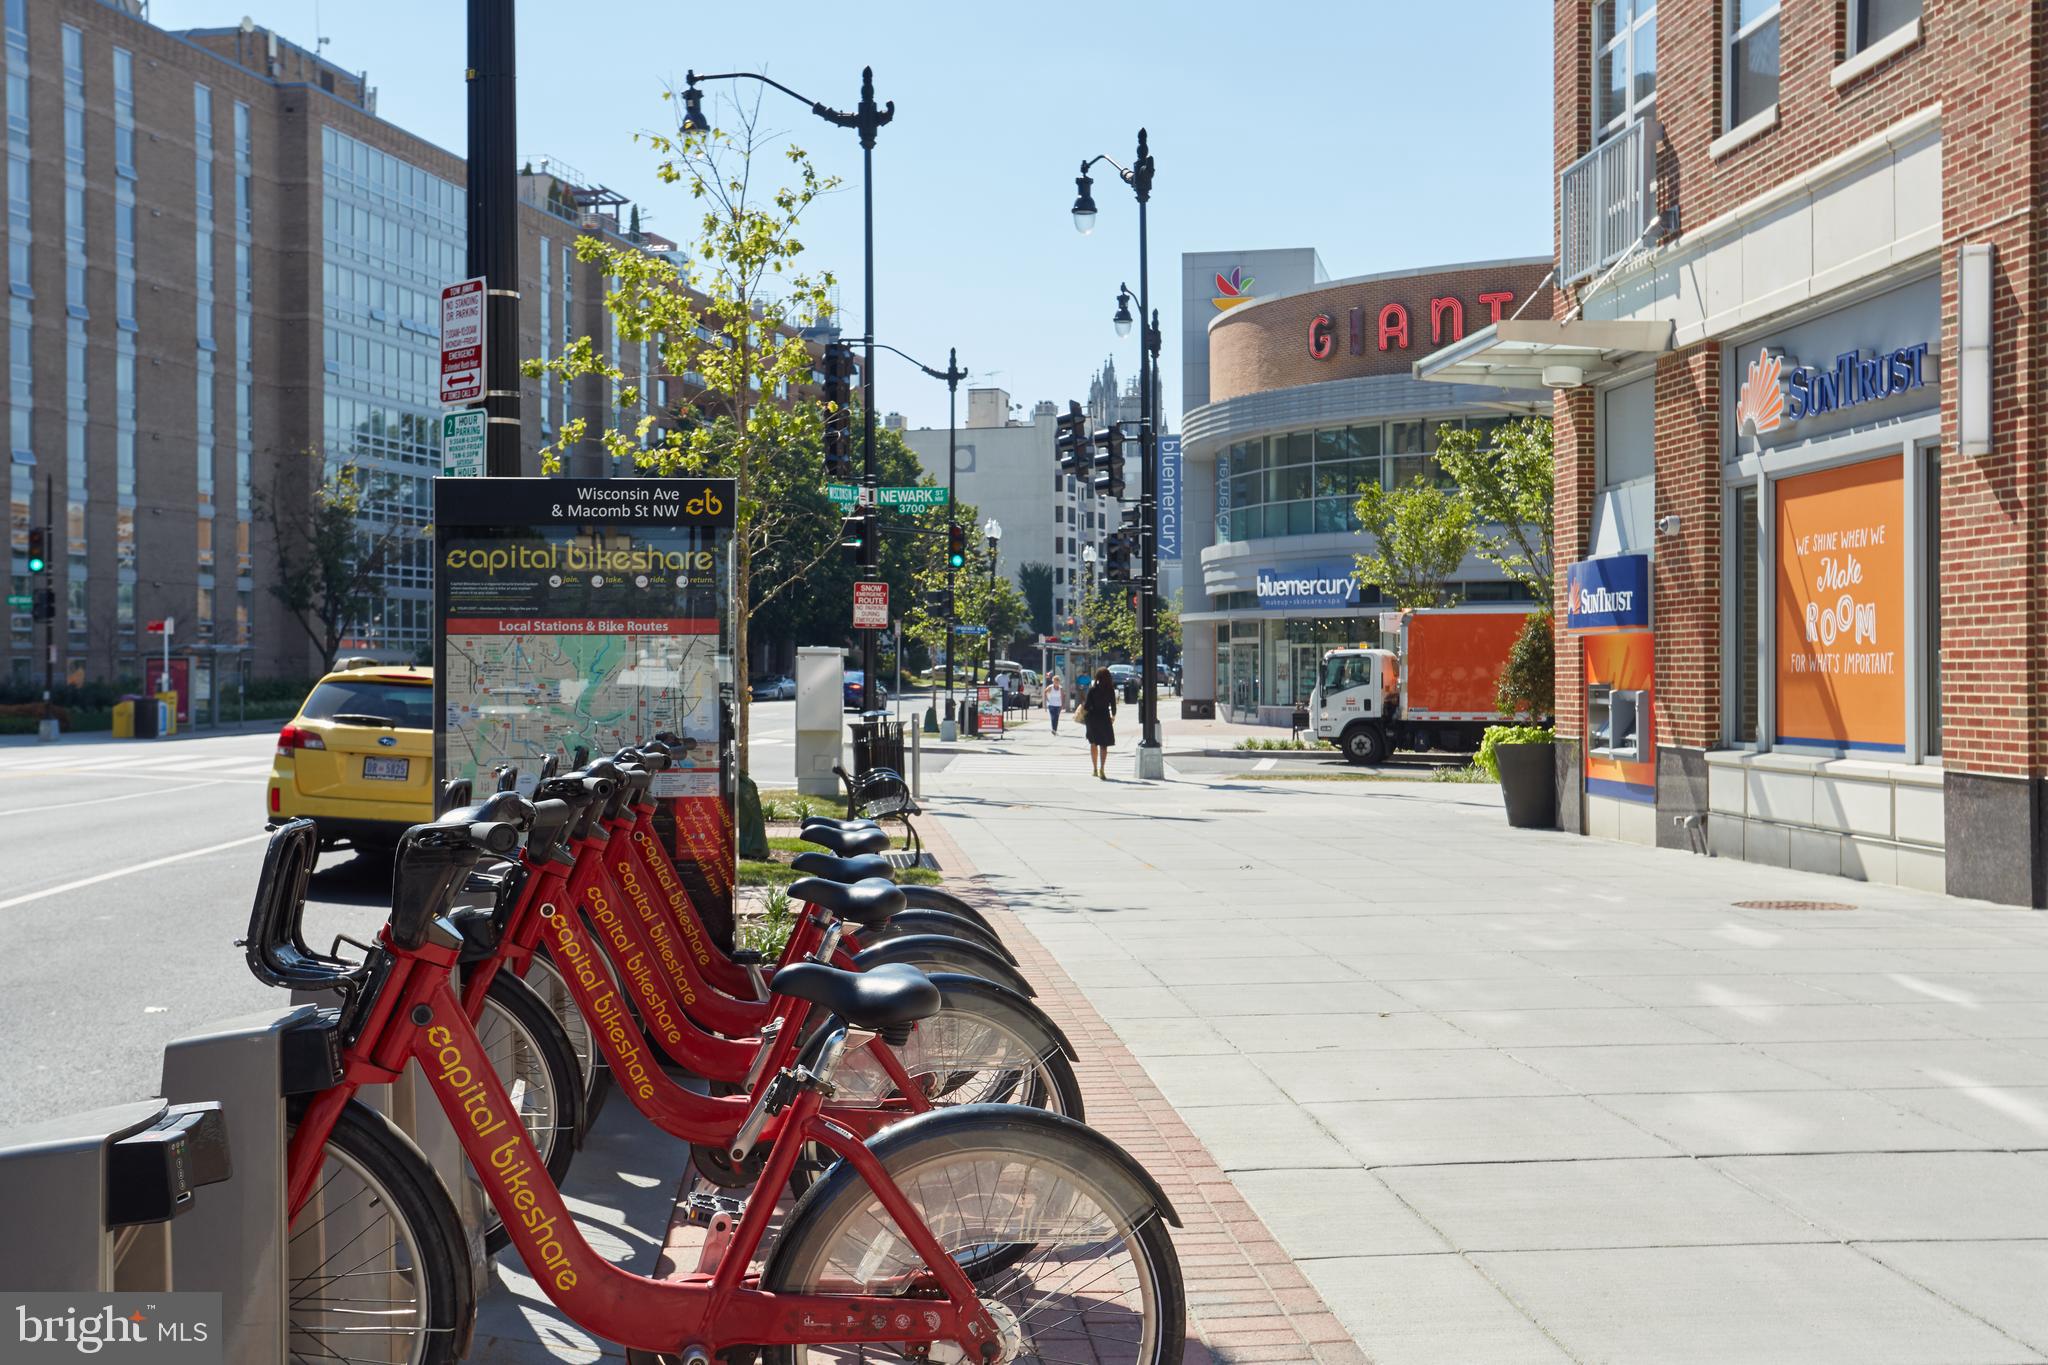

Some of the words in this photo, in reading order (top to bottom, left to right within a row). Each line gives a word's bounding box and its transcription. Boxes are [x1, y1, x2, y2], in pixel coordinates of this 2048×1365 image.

[446, 301, 454, 310] NO
[455, 294, 480, 309] STANDING
[446, 311, 454, 322] OR
[455, 306, 479, 320] PARKING
[1308, 291, 1514, 361] GIANT
[448, 349, 475, 361] EMERGENCY
[447, 419, 453, 435] 2
[458, 415, 478, 426] HOUR
[456, 425, 480, 436] PARKING
[577, 487, 650, 501] Wisconsin
[653, 487, 680, 501] Ave
[880, 489, 933, 503] NEWARK
[1158, 441, 1180, 554] bluemercury
[551, 504, 564, 517] &
[568, 504, 631, 517] Macomb
[634, 504, 649, 517] St
[653, 504, 680, 517] NW
[899, 503, 925, 514] 3700
[1796, 535, 1809, 556] WE
[1813, 531, 1838, 552] SHINE
[1841, 527, 1868, 549] WHEN
[1870, 525, 1887, 545] WE
[447, 543, 557, 576] capital
[564, 538, 714, 571] bikeshare
[562, 576, 580, 585] join.
[605, 576, 624, 584] take.
[650, 576, 667, 584] ride.
[690, 576, 715, 584] return.
[1817, 553, 1863, 592] Make
[860, 584, 882, 592] SNOW
[1256, 575, 1357, 600] bluemercury
[858, 597, 884, 605] ROUTE
[1265, 599, 1289, 607] makeup
[1293, 598, 1322, 606] skincare
[1328, 598, 1341, 606] spa
[499, 620, 531, 632] Local
[534, 620, 584, 632] Stations
[586, 620, 596, 632] &
[598, 620, 625, 632] Bike
[627, 620, 669, 632] Routes
[1806, 594, 1877, 646] ROOM
[1791, 653, 1805, 673] FOR
[1809, 652, 1840, 673] WHAT'S
[1844, 651, 1895, 675] IMPORTANT.
[641, 837, 677, 890] capital
[669, 889, 710, 965] bikeshare
[618, 862, 659, 922] capital
[650, 921, 696, 1005] bikeshare
[587, 886, 636, 953] capital
[626, 951, 681, 1045] bikeshare
[551, 914, 605, 992] capital
[594, 990, 655, 1099] bikeshare
[427, 1025, 507, 1138] capital
[490, 1135, 578, 1291] bikeshare
